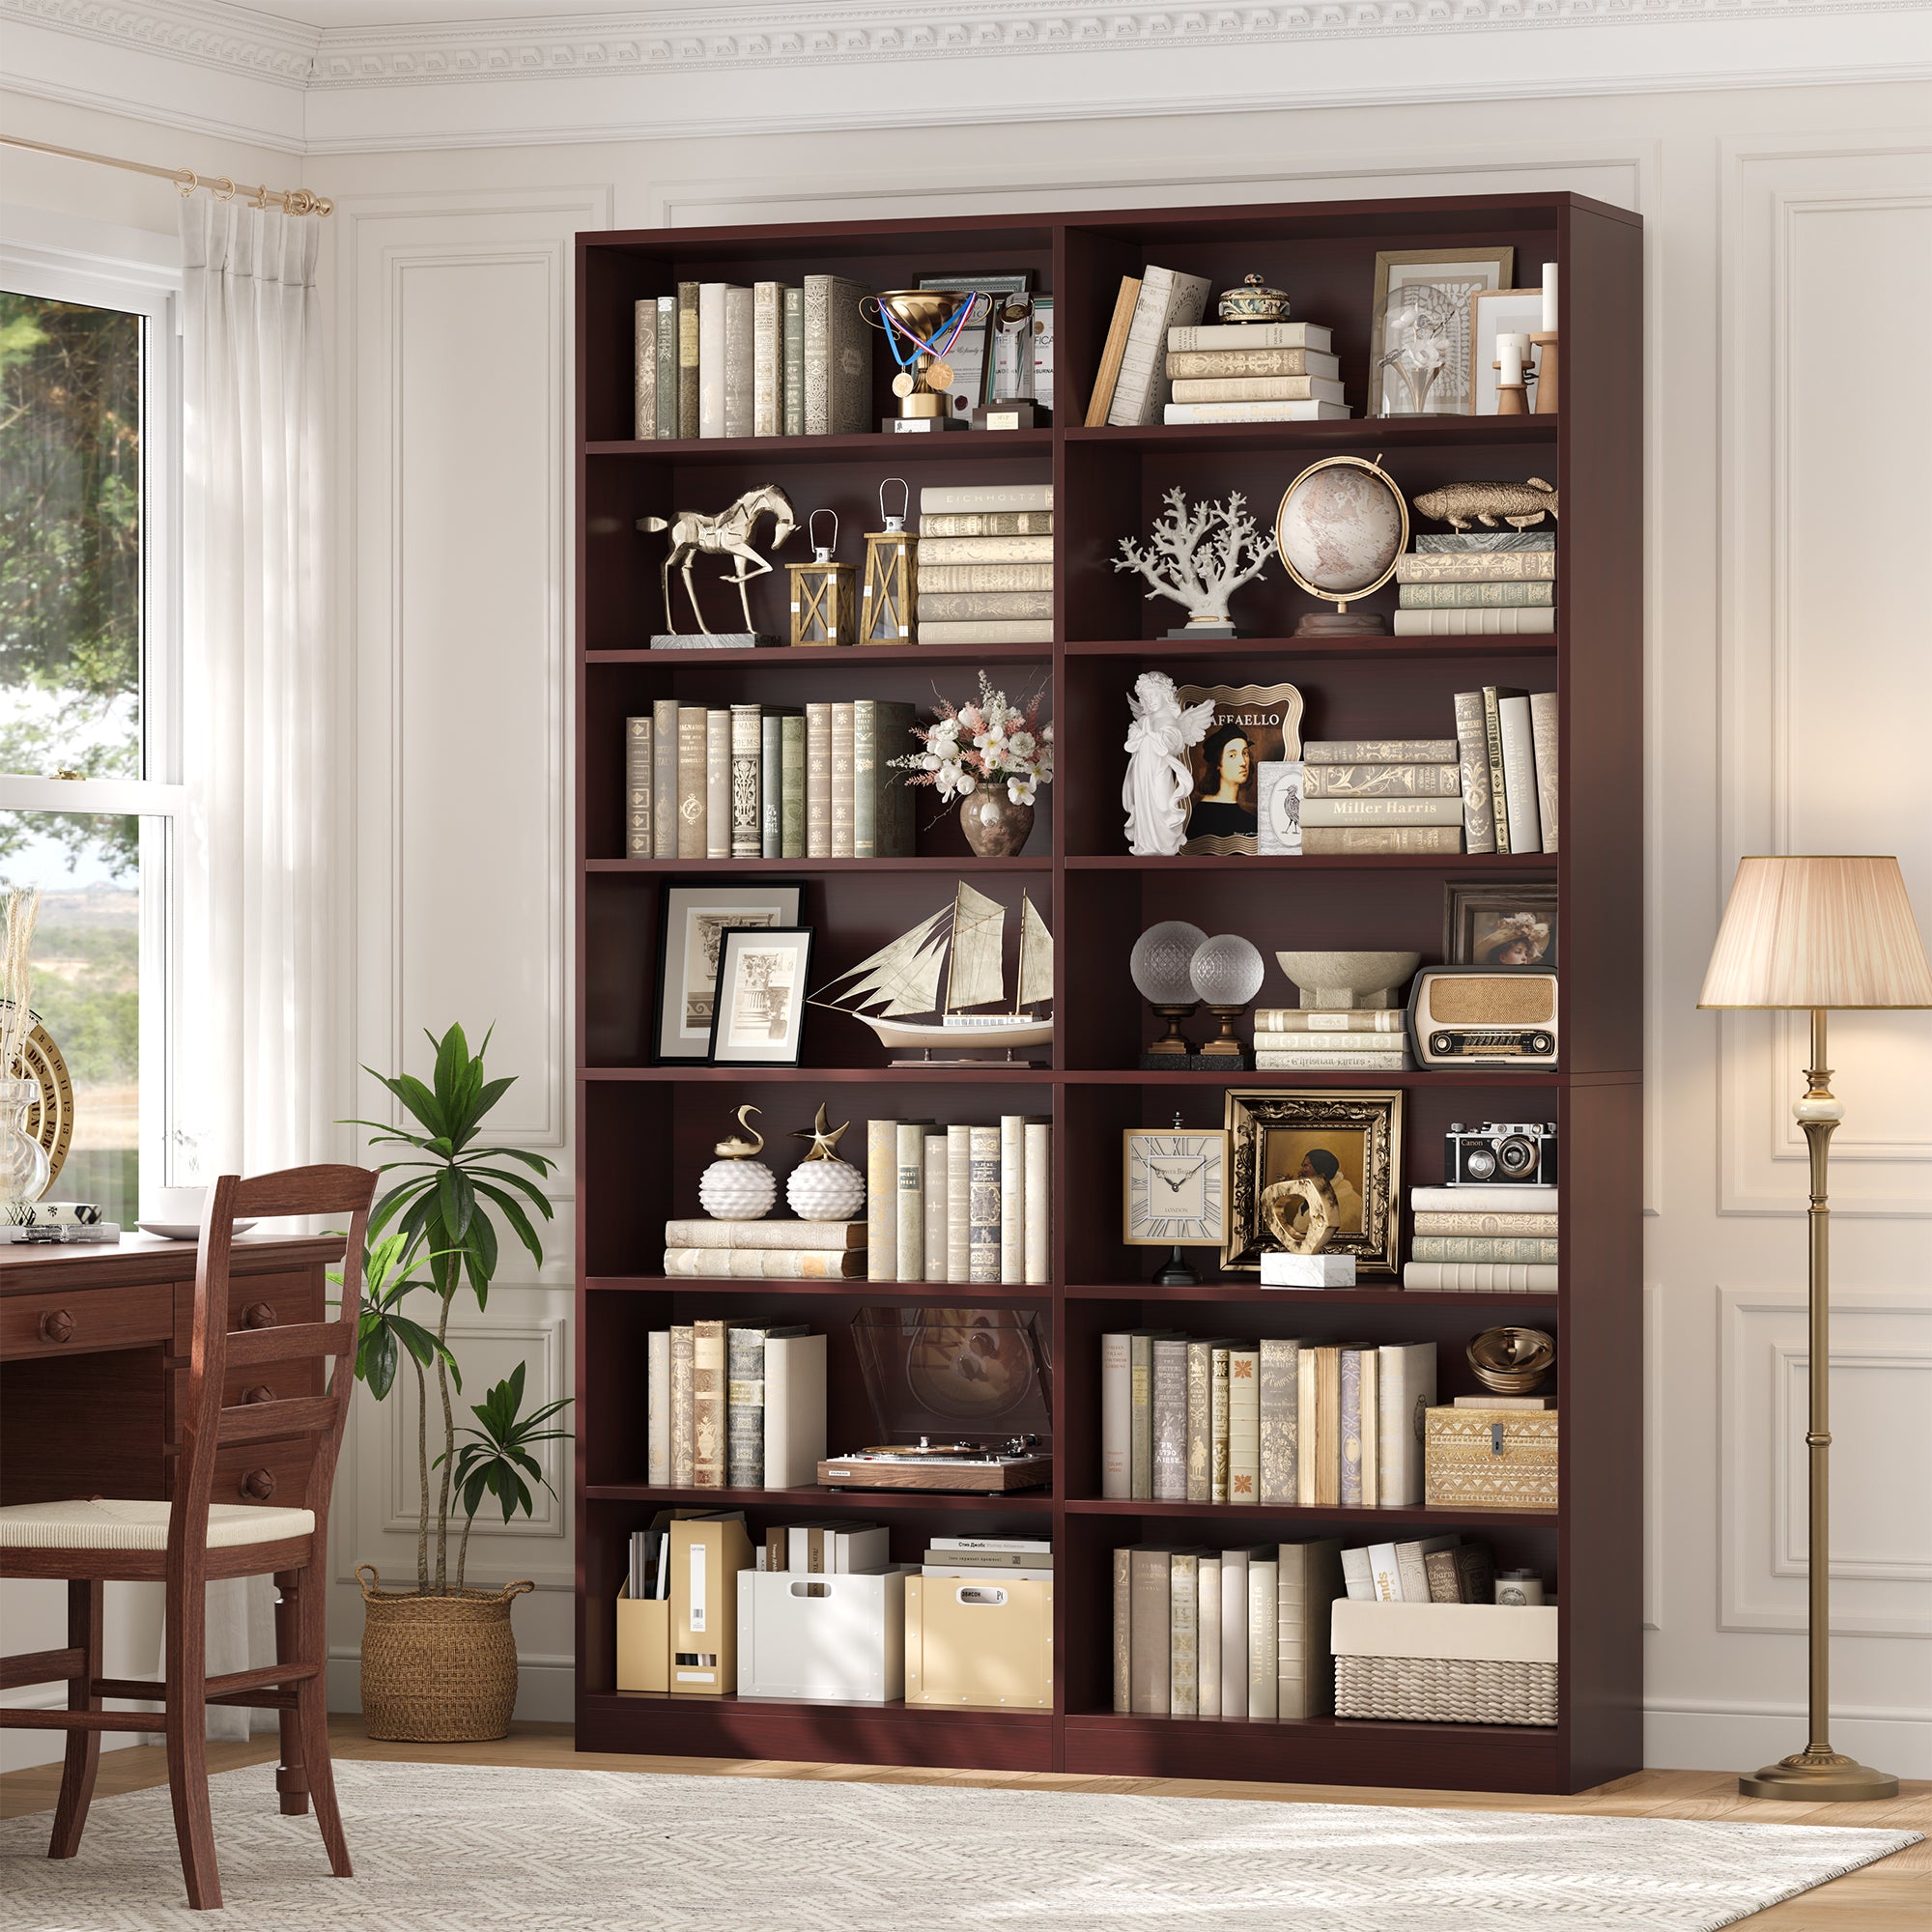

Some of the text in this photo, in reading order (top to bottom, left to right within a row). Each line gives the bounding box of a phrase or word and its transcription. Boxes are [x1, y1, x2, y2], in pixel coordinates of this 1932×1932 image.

[1192, 404, 1293, 418] Furniture Brands
[946, 494, 1037, 503] EICHHOLTZ
[1210, 714, 1280, 725] AFFAELLO
[1333, 801, 1436, 814] Miller Harris
[27, 1048, 47, 1075] DES
[54, 1059, 63, 1071] 10
[60, 1079, 69, 1091] 11
[44, 1083, 56, 1112] JAN
[64, 1101, 71, 1113] 12
[63, 1122, 71, 1135] 13
[1160, 1441, 1173, 1450] PR
[1428, 1570, 1455, 1581] Charm
[1251, 1584, 1263, 1685] Miller Harris
